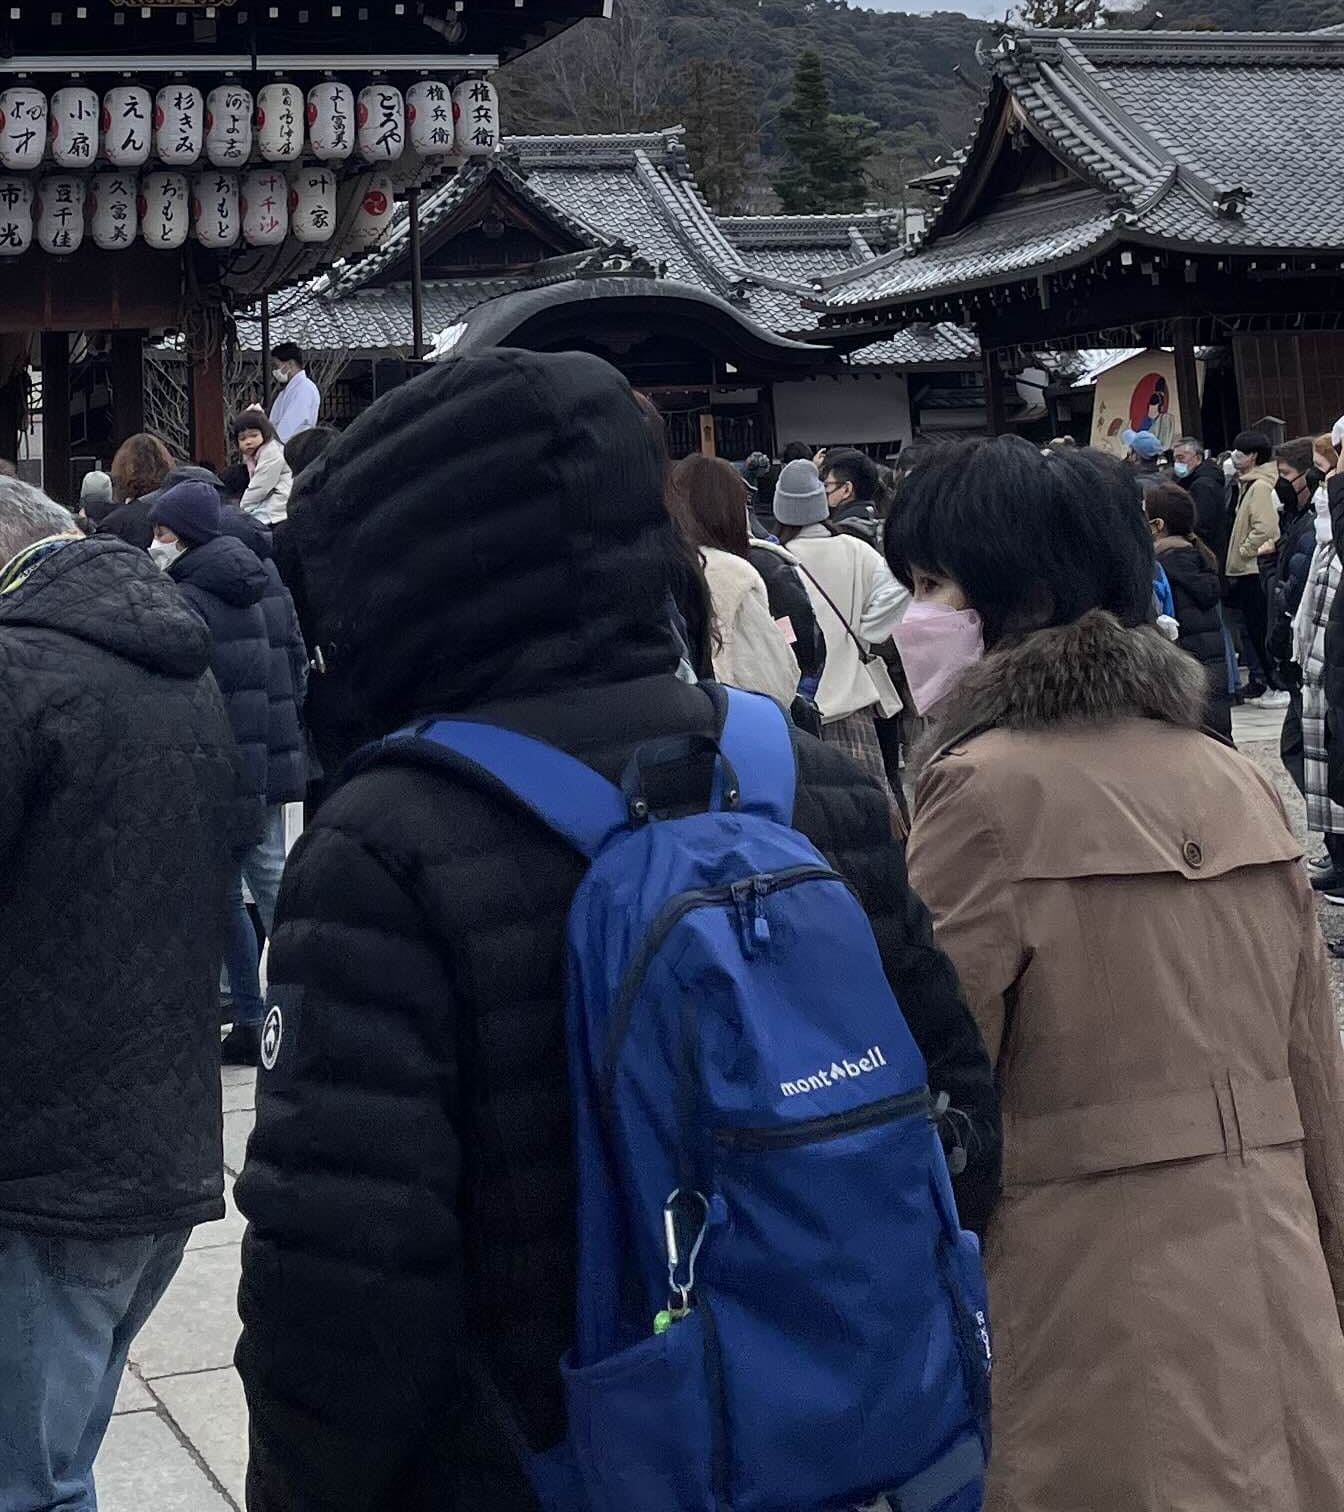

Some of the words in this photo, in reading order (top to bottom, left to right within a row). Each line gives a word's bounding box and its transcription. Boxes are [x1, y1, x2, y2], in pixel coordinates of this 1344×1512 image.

[66, 100, 92, 158] 小扇
[120, 95, 145, 152] えん
[173, 92, 196, 154] 杉きみ
[161, 178, 177, 241] ちもと
[215, 176, 231, 239] ちもと
[308, 174, 330, 229] 叶家
